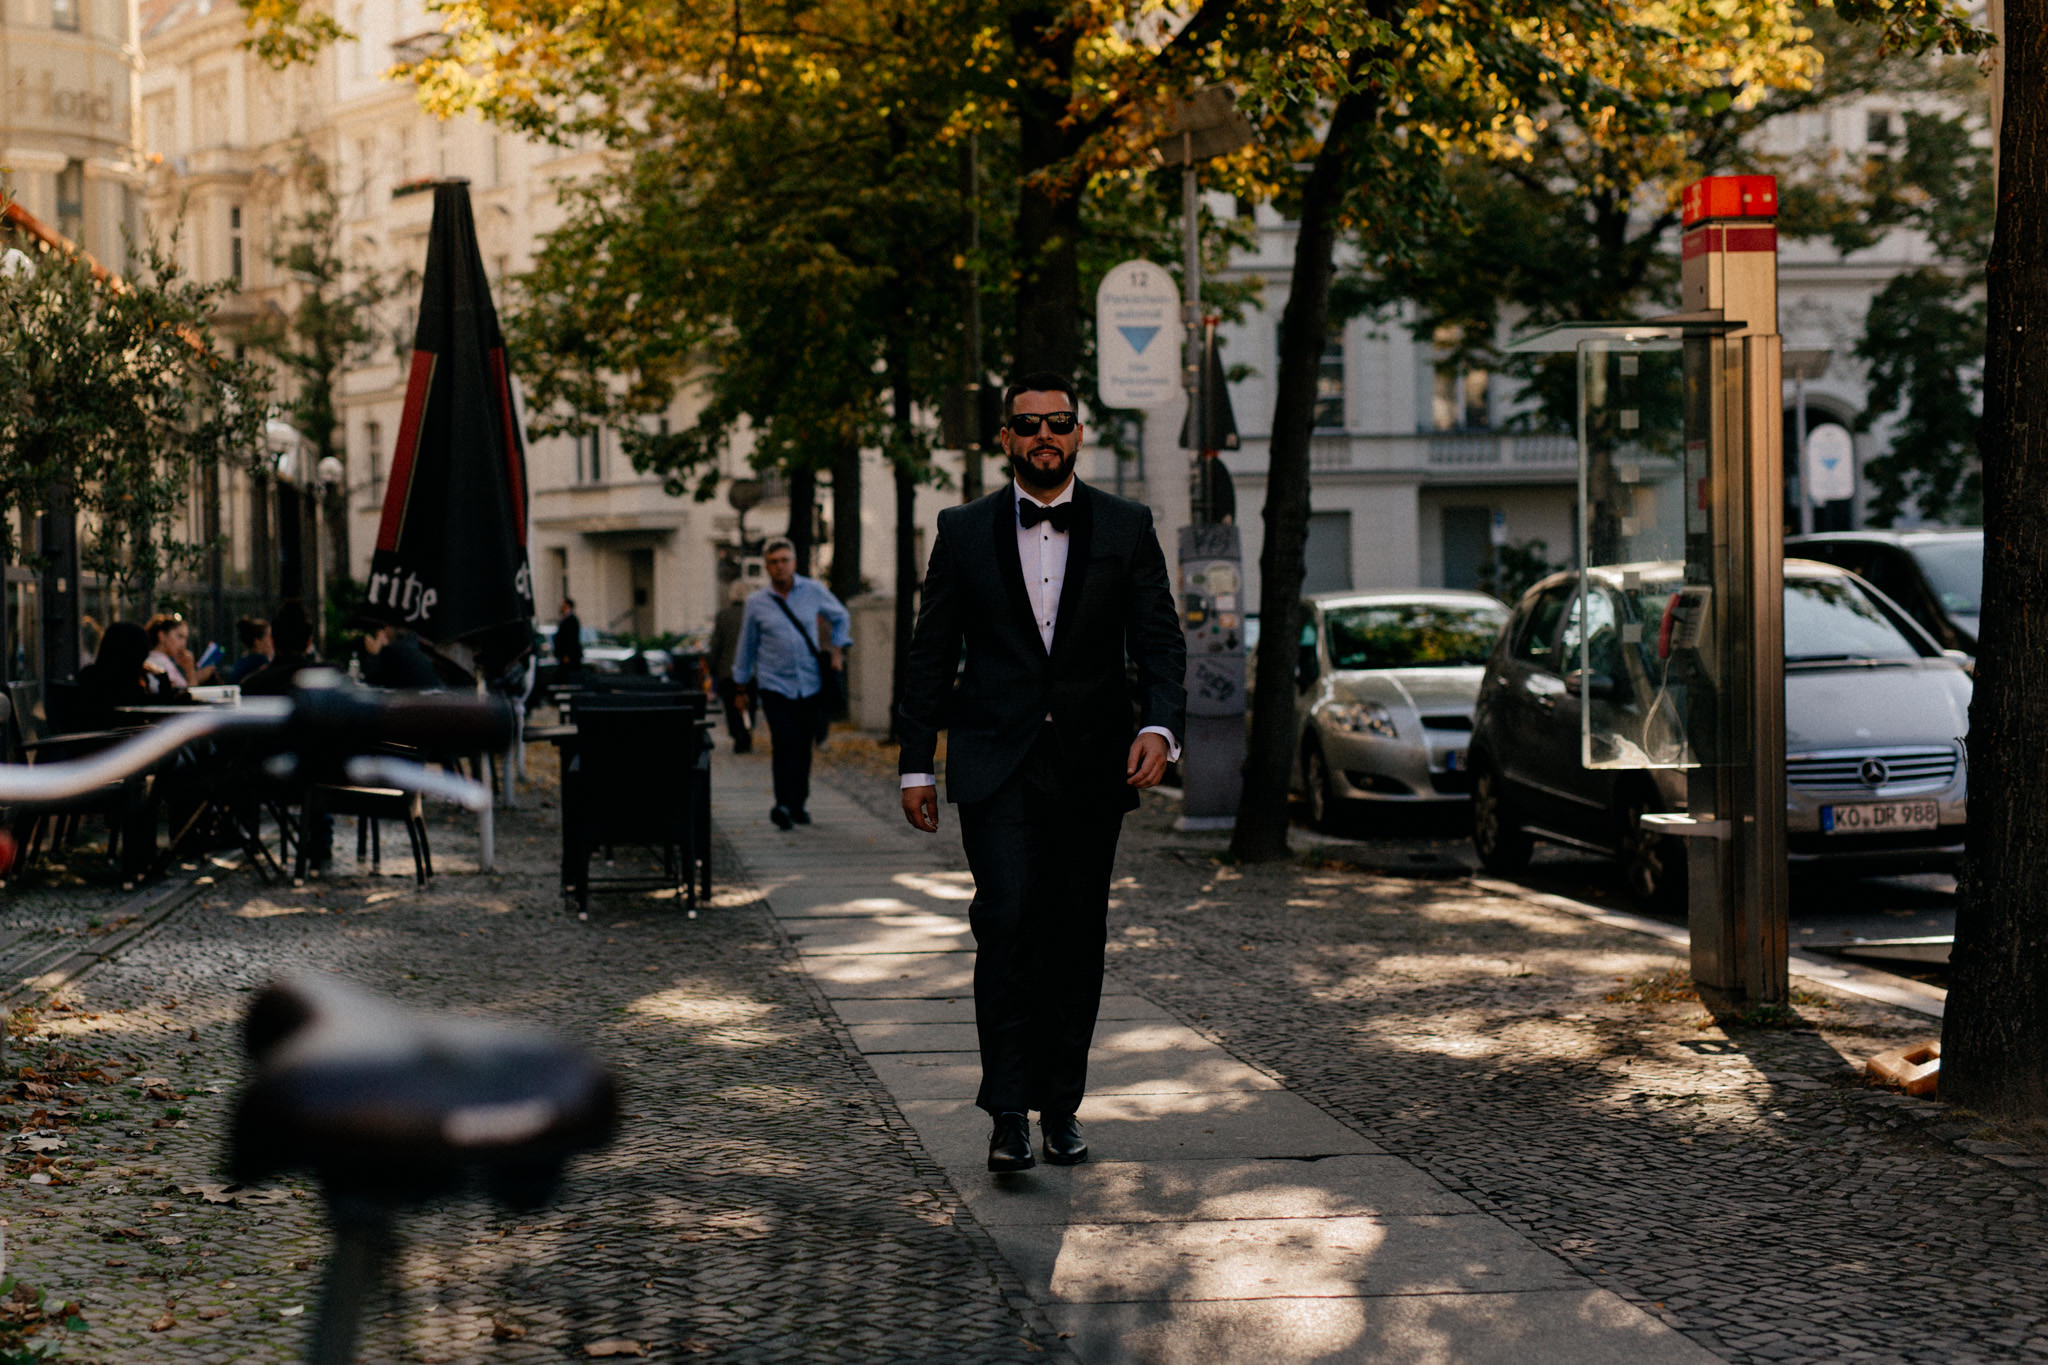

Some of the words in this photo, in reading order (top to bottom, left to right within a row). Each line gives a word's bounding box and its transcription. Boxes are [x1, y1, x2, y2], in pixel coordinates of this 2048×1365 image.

[1130, 272, 1148, 287] 12
[1874, 807, 1896, 825] DR
[1902, 805, 1936, 823] 988
